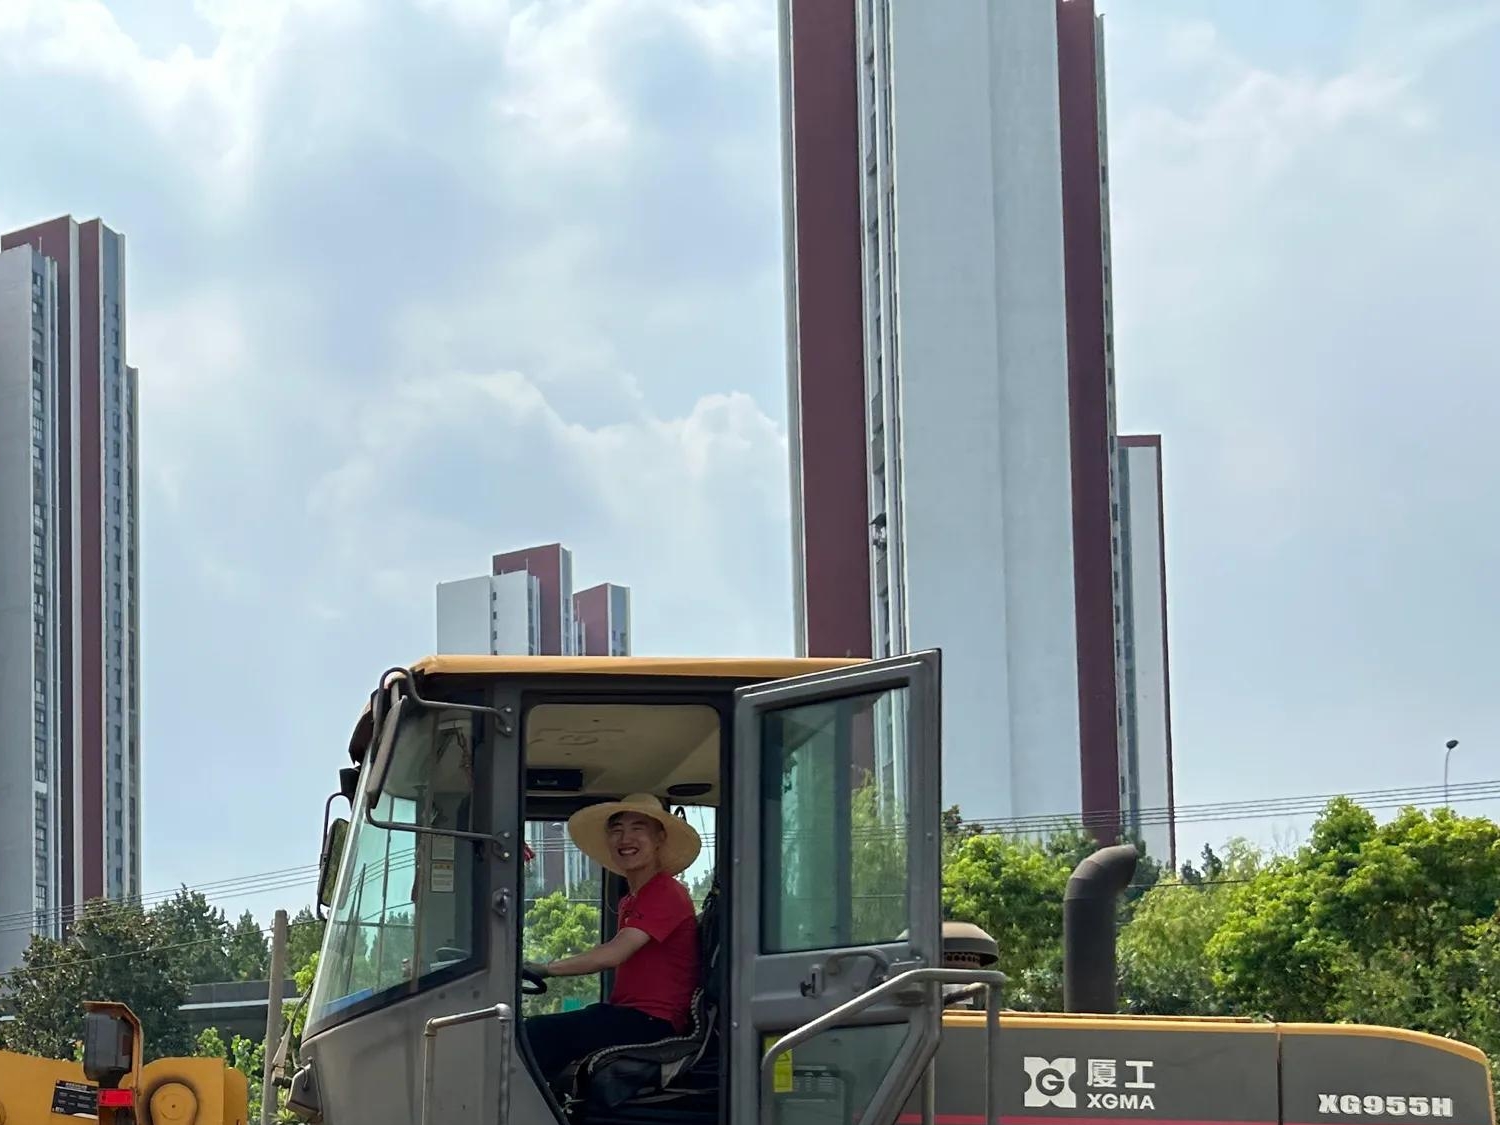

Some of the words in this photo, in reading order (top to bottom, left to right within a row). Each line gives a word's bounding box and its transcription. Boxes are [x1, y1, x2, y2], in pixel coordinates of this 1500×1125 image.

[1086, 1058, 1156, 1089] 厦工
[1086, 1093, 1156, 1110] XGMA
[1318, 1094, 1454, 1118] XG955H
